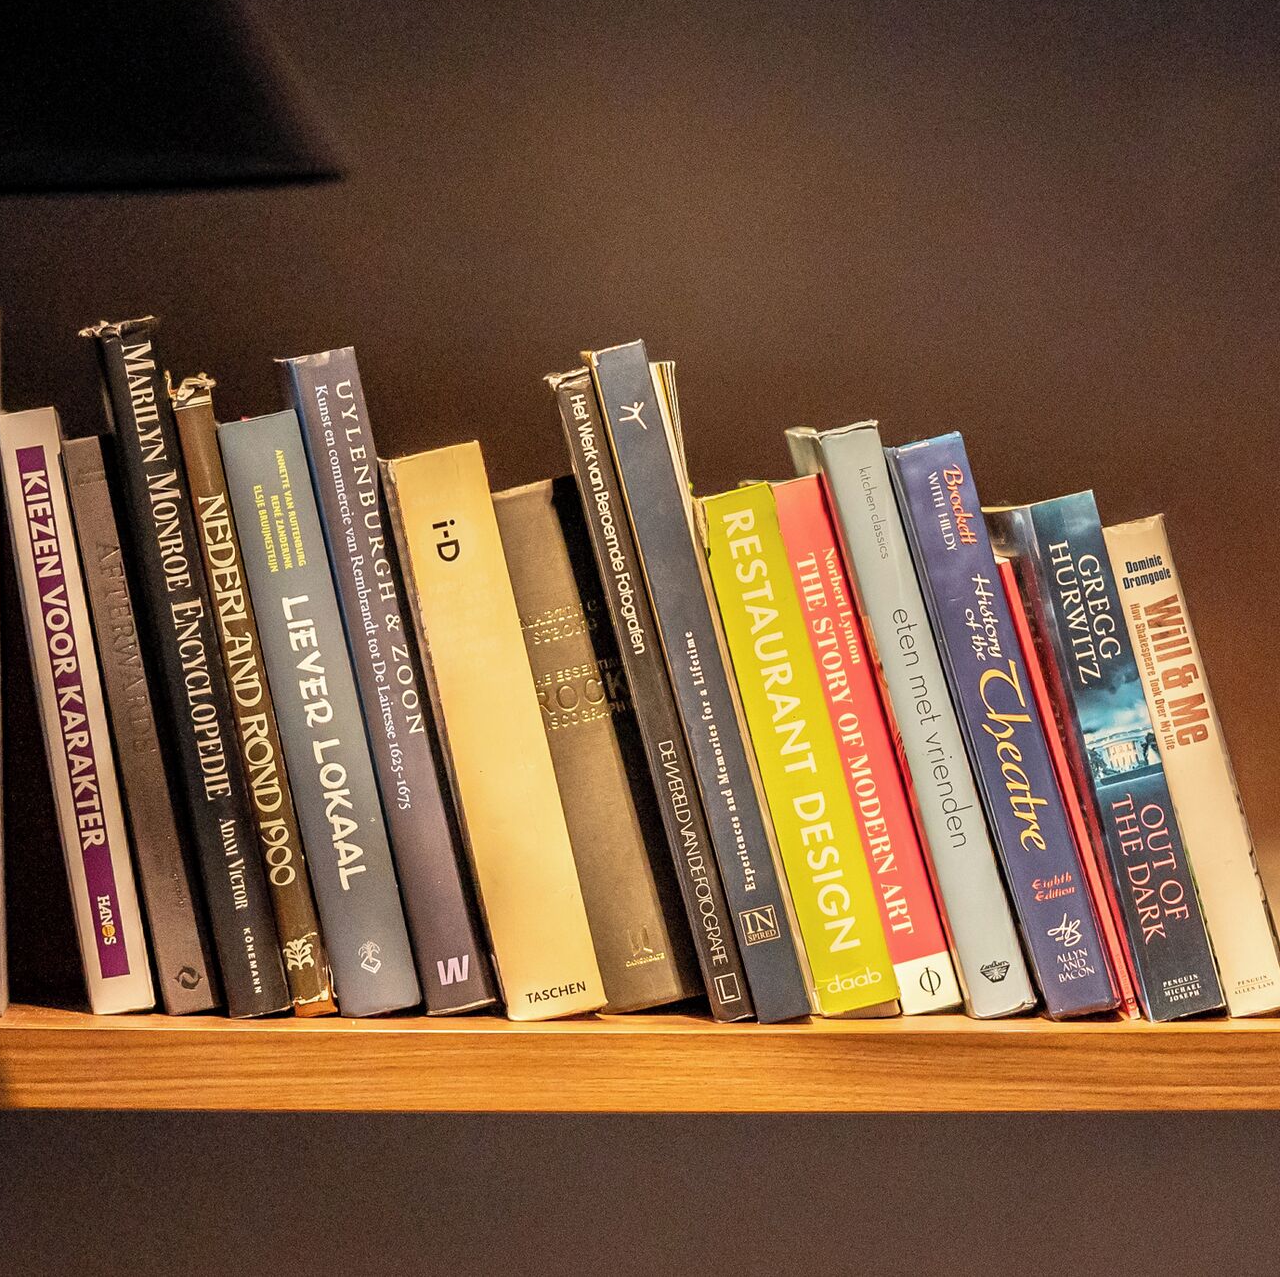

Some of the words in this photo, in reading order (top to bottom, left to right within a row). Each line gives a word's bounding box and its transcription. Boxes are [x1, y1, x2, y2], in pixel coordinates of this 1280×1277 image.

[315, 384, 333, 429] Kunst
[570, 393, 589, 422] Het
[324, 429, 336, 447] en
[577, 421, 598, 462] Werk
[274, 449, 291, 490] ANNETTE
[328, 449, 356, 528] commercie
[335, 378, 397, 603] UYLENBURGH
[587, 459, 604, 493] van
[253, 484, 266, 509] ELSJE
[270, 494, 285, 518] RENÉ
[283, 490, 295, 510] VAN
[858, 465, 876, 512] kitchen
[870, 513, 889, 561] classics
[927, 470, 947, 510] WITH
[937, 511, 958, 551] HILDY
[942, 462, 979, 546] Brockett
[21, 469, 62, 579] KIEZEN
[258, 509, 280, 574] BRUIJNESTEIJN
[275, 518, 294, 570] ZANDERINK
[287, 510, 307, 567] RUITENBURG
[344, 528, 358, 554] van
[431, 518, 461, 563] i-D
[594, 491, 625, 573] Beroemde
[121, 338, 168, 464] MARILYN
[146, 468, 192, 593] MONROE
[171, 596, 233, 802] ENCYCLOPEDIE
[795, 551, 828, 612] THE
[1122, 567, 1172, 591] Dromgoole
[1124, 553, 1163, 575] Dominic
[197, 491, 264, 708] NEDERLAND
[350, 554, 380, 638] Rembrandt
[615, 571, 646, 656] Fotografen
[822, 546, 845, 607] Norbert
[838, 606, 862, 664] Lynton
[964, 607, 983, 630] of
[971, 573, 1003, 659] History
[1048, 539, 1102, 685] HURWITZ
[1077, 553, 1122, 661] GREGG
[1129, 602, 1143, 622] How
[42, 584, 78, 679] VOOR
[384, 613, 401, 632] &
[892, 608, 920, 667] eten
[971, 628, 987, 662] the
[1142, 593, 1194, 664] Will
[367, 636, 381, 660] tot
[372, 660, 387, 682] De
[684, 629, 705, 686] Lifetime
[812, 615, 854, 706] STORY
[1135, 622, 1157, 678] Shakespeare
[391, 643, 425, 735] ZOON
[699, 688, 708, 697] a
[908, 674, 943, 726] met
[1149, 677, 1160, 698] Took
[1160, 662, 1200, 692] &
[377, 684, 397, 740] Lairesse
[701, 700, 714, 721] for
[722, 507, 817, 775] RESTAURANT
[792, 790, 861, 954] DESIGN
[837, 712, 866, 748] OF
[1154, 698, 1168, 718] Over
[1160, 719, 1172, 734] My
[1167, 692, 1212, 748] Me
[239, 712, 283, 814] ROND
[282, 594, 334, 729] LIEVER
[312, 737, 367, 892] LOKAAL
[658, 739, 678, 761] DE
[708, 724, 730, 786] Memories
[978, 658, 1049, 853] Theatre
[1163, 731, 1176, 752] Life
[58, 684, 107, 851] KARAKTER
[388, 740, 412, 811] 1625-1675
[925, 730, 974, 849] vrienden
[663, 760, 692, 824] WERELD
[720, 788, 738, 813] and
[846, 753, 899, 875] MODERN
[680, 821, 699, 857] VAN
[1110, 792, 1145, 857] THE
[1140, 802, 1178, 872] OUT
[258, 817, 296, 887] 1900
[688, 853, 706, 878] DE
[730, 814, 756, 892] Experiences
[1031, 870, 1073, 891] Eighth
[1034, 885, 1076, 903] Edition
[1126, 860, 1168, 946] DARK
[1158, 879, 1191, 921] OF
[96, 894, 117, 946] HANOS
[693, 875, 729, 968] FOTOGRAFIE
[742, 907, 775, 936] IN
[880, 882, 915, 935] ART
[747, 928, 778, 943] SPIRED
[1055, 947, 1089, 964] ALLYN
[436, 954, 469, 987] W
[826, 966, 883, 994] daab
[1057, 966, 1097, 984] BACON
[1062, 957, 1087, 973] AND
[1161, 973, 1200, 988] PENGUIN
[1233, 983, 1257, 996] ALLEN
[1257, 980, 1276, 992] LANE
[1236, 973, 1268, 988] PENGUIN
[525, 980, 587, 1005] TASCHEN
[1163, 982, 1203, 998] MICHAEL
[1168, 989, 1201, 1004] JOSEPH
